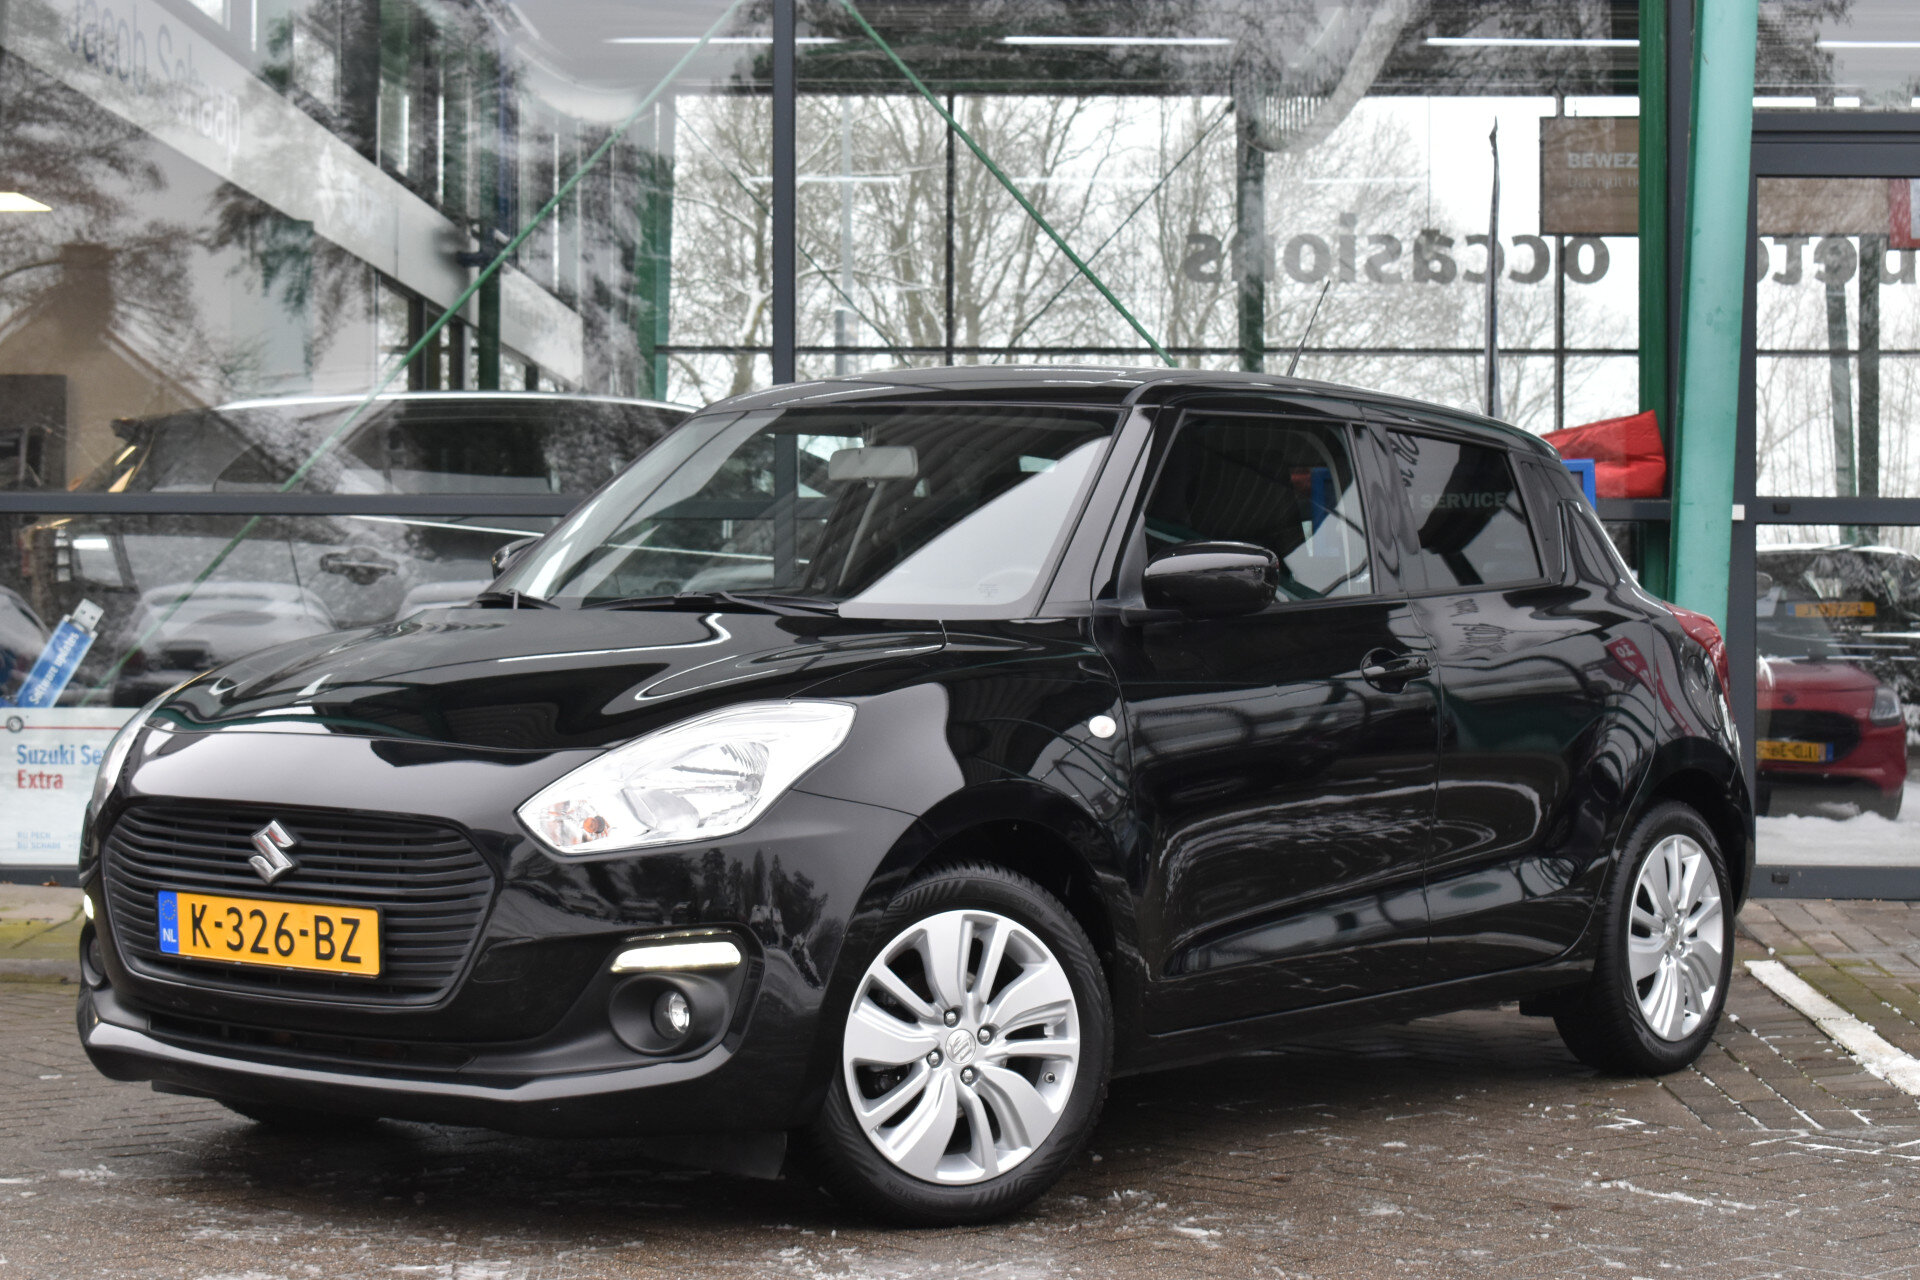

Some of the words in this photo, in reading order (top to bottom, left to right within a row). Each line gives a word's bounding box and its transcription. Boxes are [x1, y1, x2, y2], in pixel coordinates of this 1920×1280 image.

[1420, 491, 1506, 509] SERVICE
[17, 744, 75, 765] Suzuki
[81, 744, 104, 765] Se
[17, 769, 64, 790] Extra
[162, 928, 177, 944] NL
[190, 903, 362, 964] K-326-BZ
